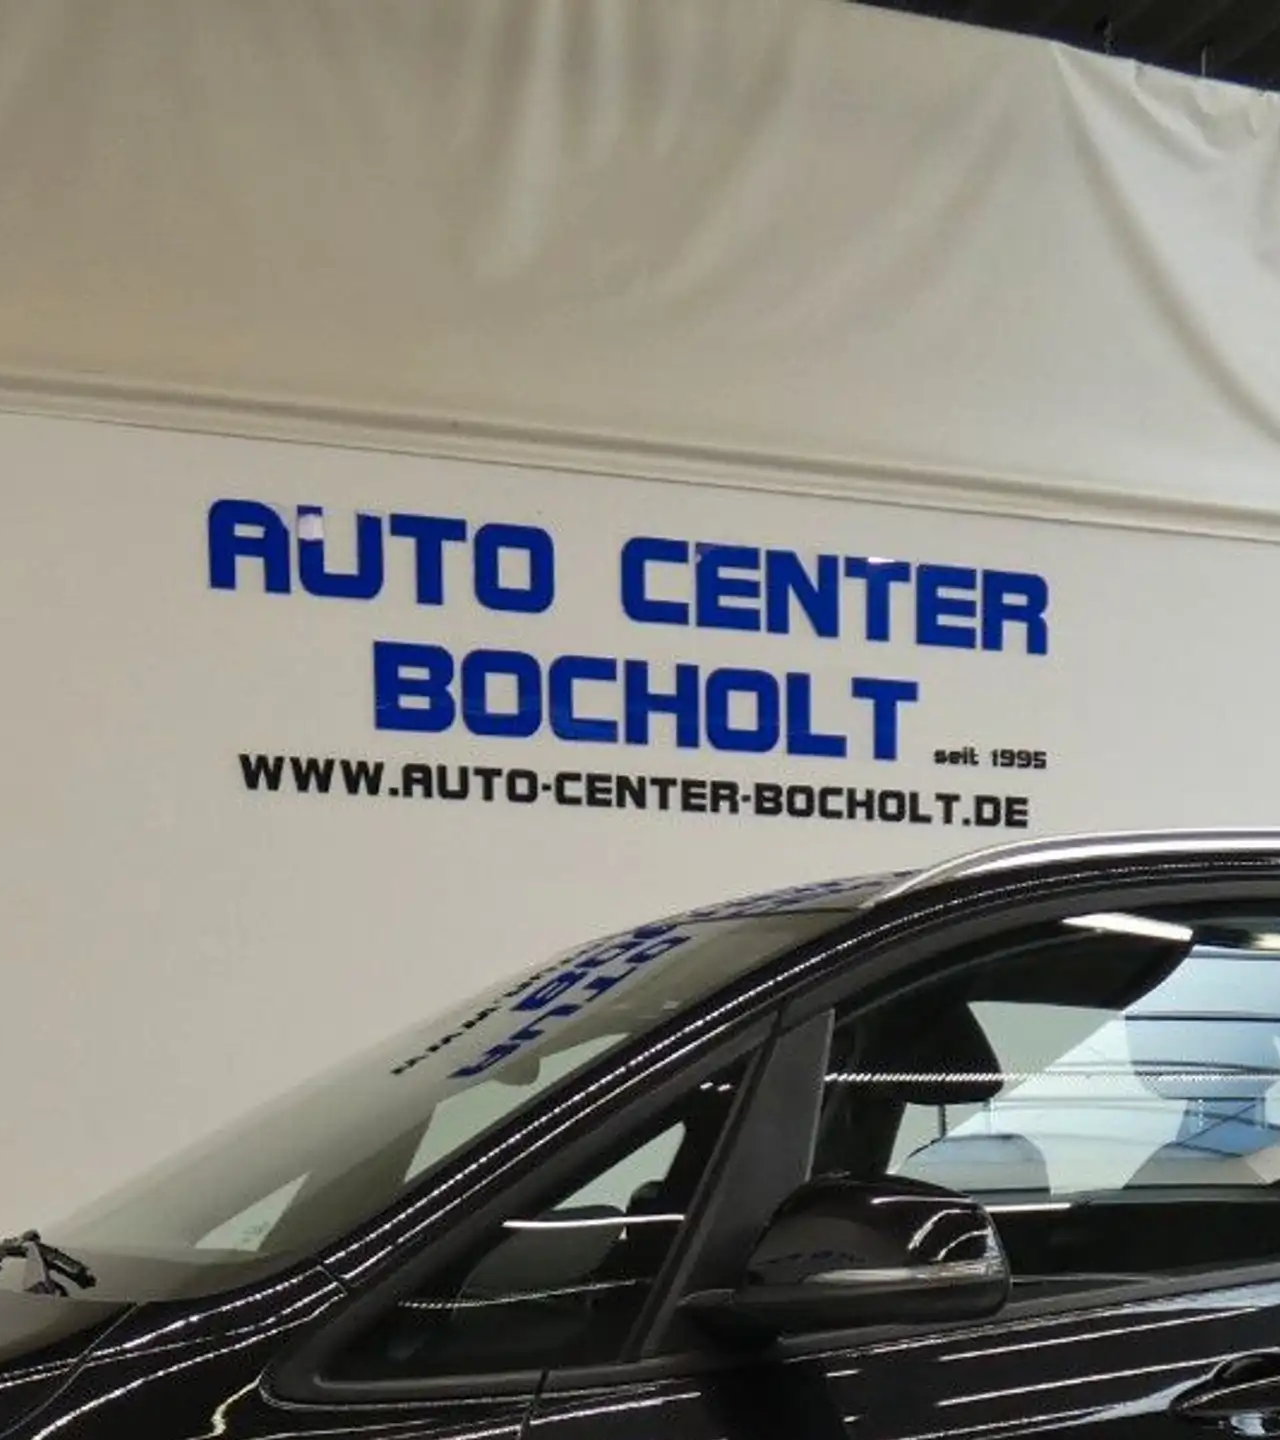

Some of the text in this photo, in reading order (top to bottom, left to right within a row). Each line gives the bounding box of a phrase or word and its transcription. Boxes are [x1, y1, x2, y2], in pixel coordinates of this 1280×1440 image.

[208, 499, 1049, 656] AUTO CENTER
[373, 641, 920, 762] BOCHOLT
[238, 753, 1029, 829] WWW.AUTO-CENTER-BOCHOLT.DE
[933, 746, 1047, 769] seit 1995
